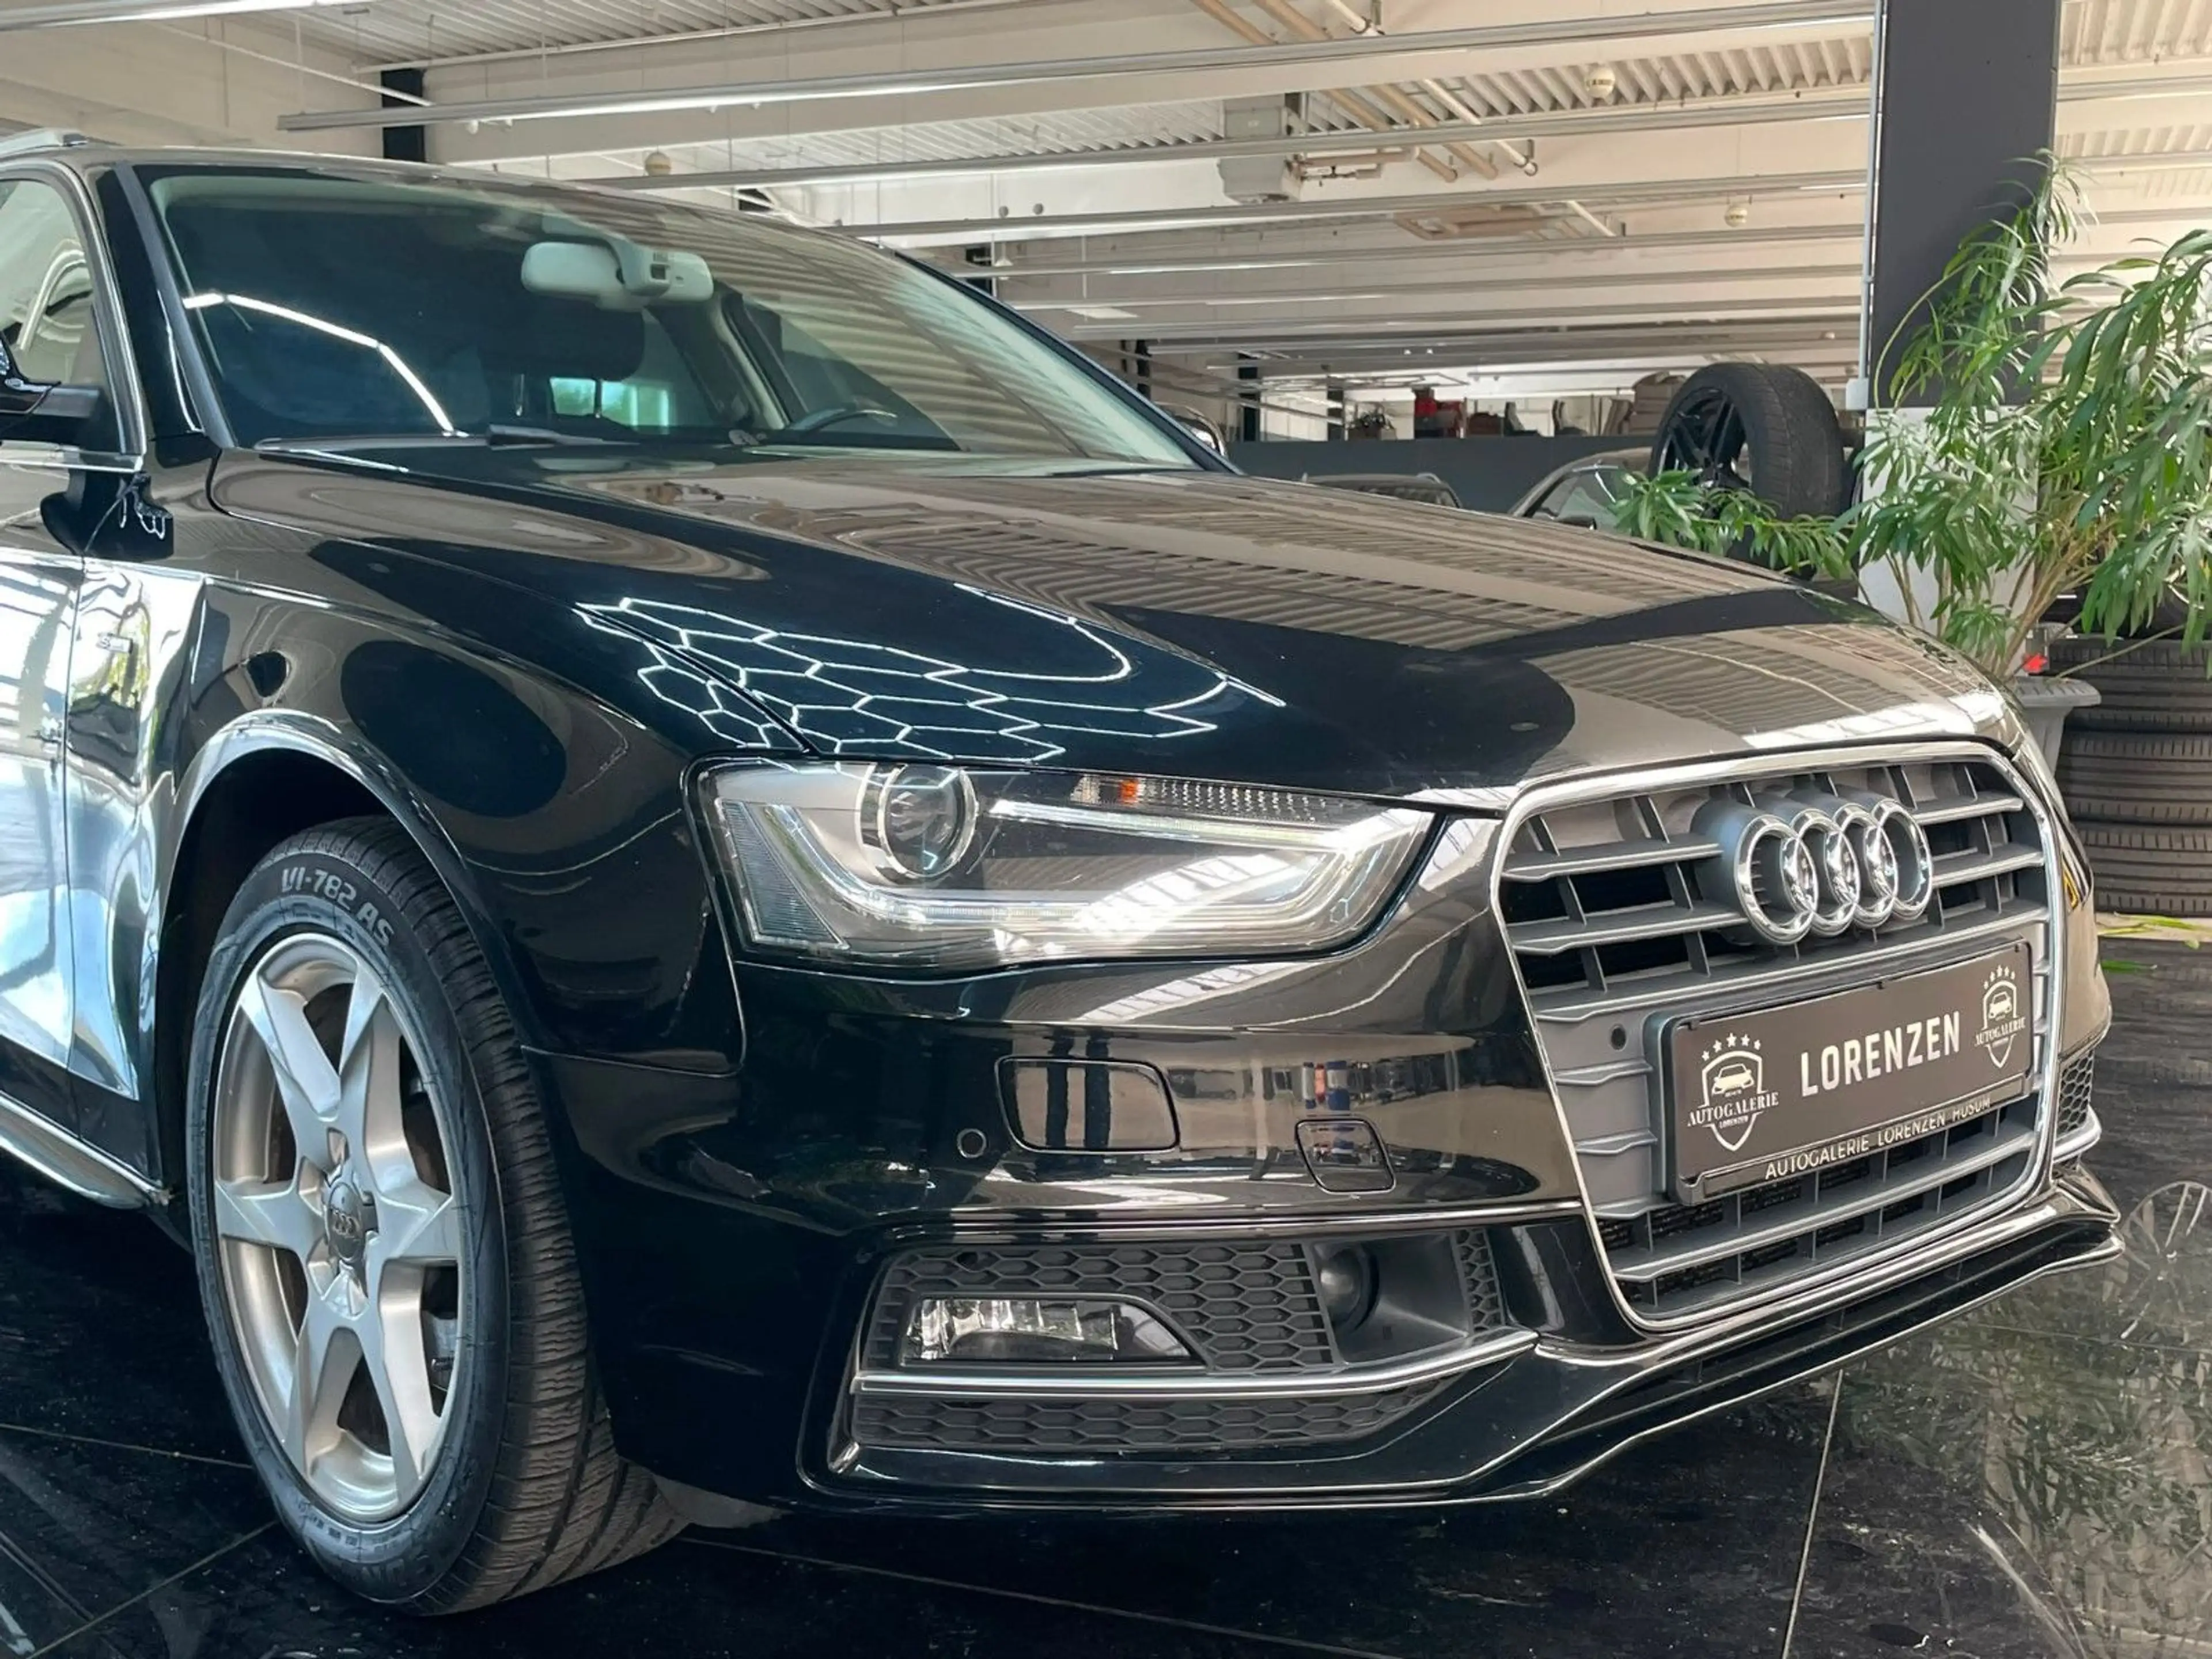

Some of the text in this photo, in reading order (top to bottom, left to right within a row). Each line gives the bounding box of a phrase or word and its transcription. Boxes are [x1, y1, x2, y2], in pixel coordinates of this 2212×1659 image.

[282, 866, 395, 946] VI-782 AS
[1801, 1010, 1960, 1097] LORENZEN
[1687, 1092, 1779, 1126] AUTOGALERIE
[1765, 1134, 1870, 1180] AUTOGALERIE
[1877, 1110, 1945, 1147] LORENZEN
